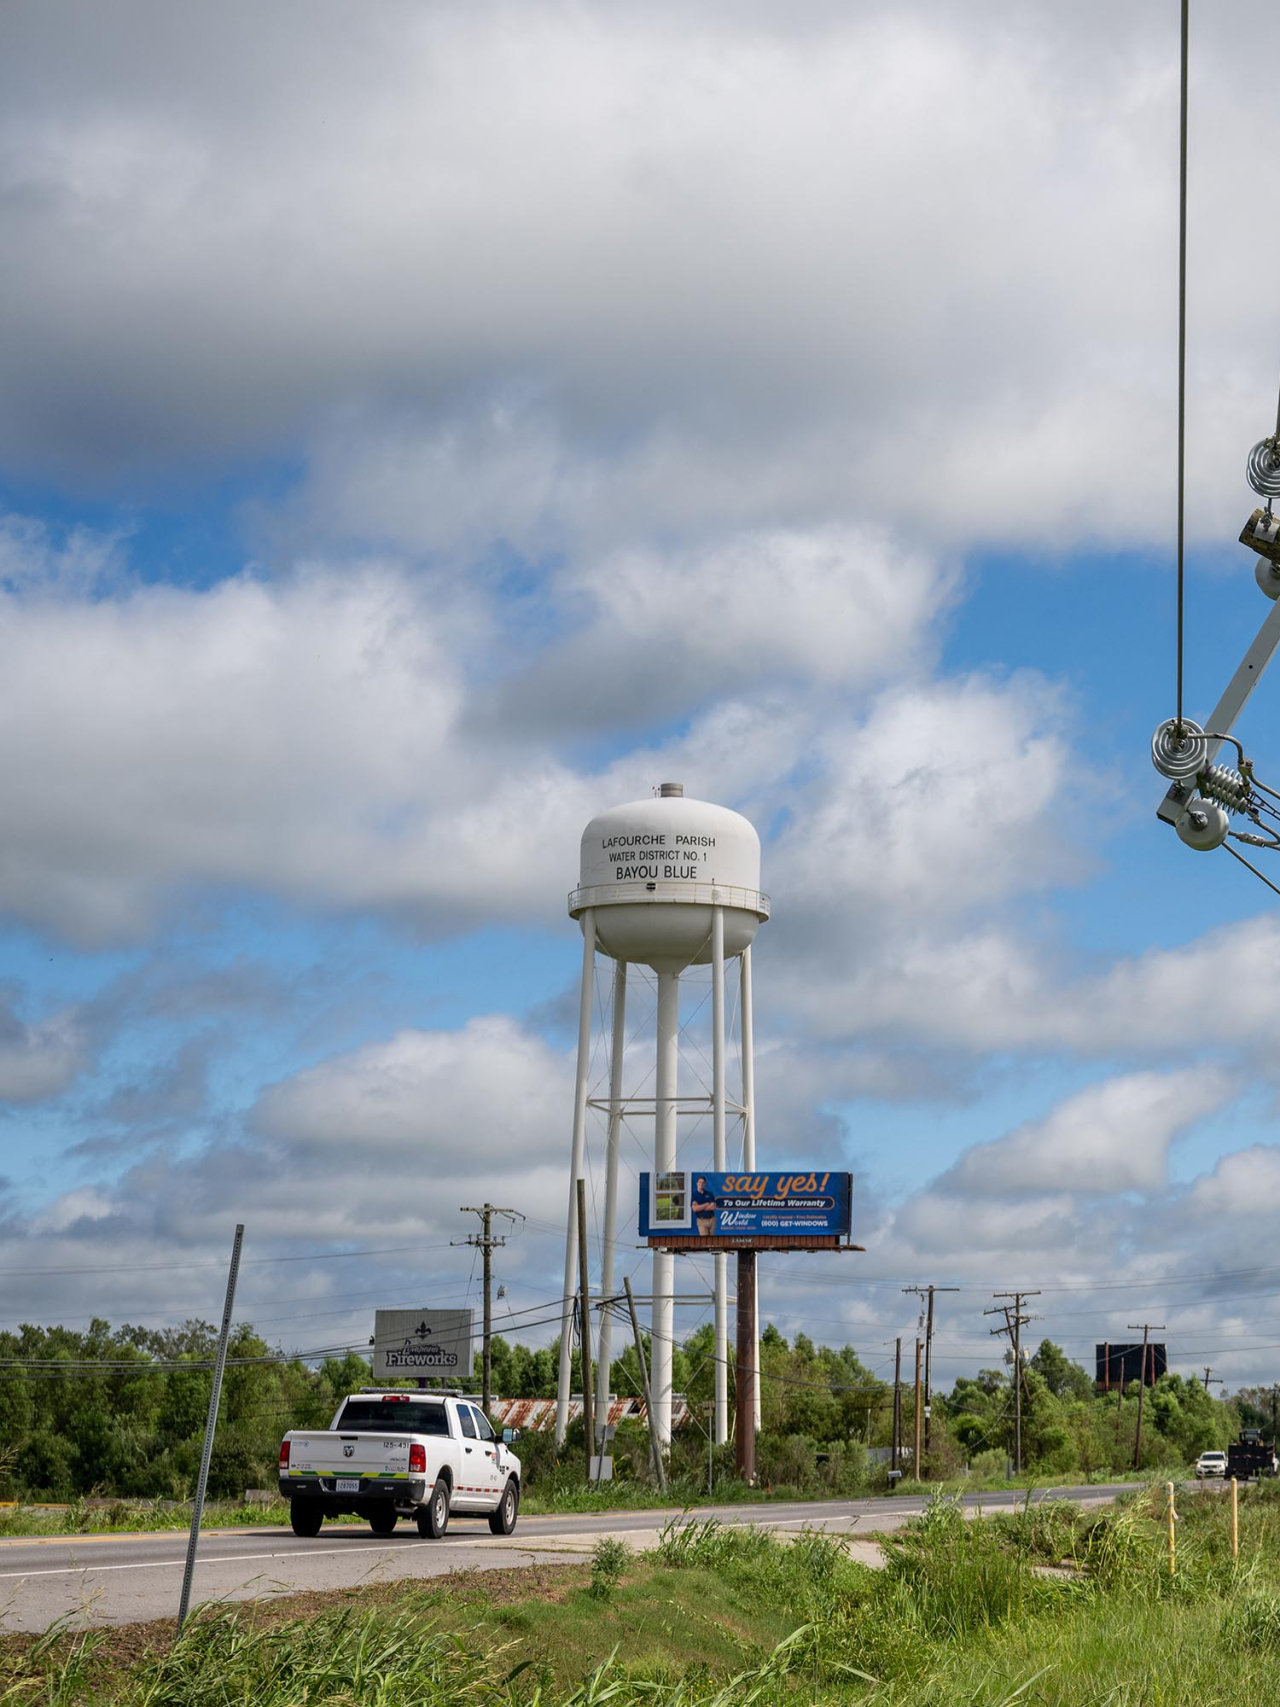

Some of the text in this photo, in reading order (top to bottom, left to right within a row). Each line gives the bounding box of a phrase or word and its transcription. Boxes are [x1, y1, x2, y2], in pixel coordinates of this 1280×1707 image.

[602, 835, 716, 849] LAFOURCHE PARISH
[609, 850, 707, 863] WATER DISTRICT NO. 1
[616, 865, 698, 880] BAYOU BLUE
[722, 1172, 830, 1200] say yes!
[723, 1199, 826, 1208] To Our Lifetime Warranty
[761, 1220, 778, 1228] (800)
[387, 1350, 457, 1366] Fireworks
